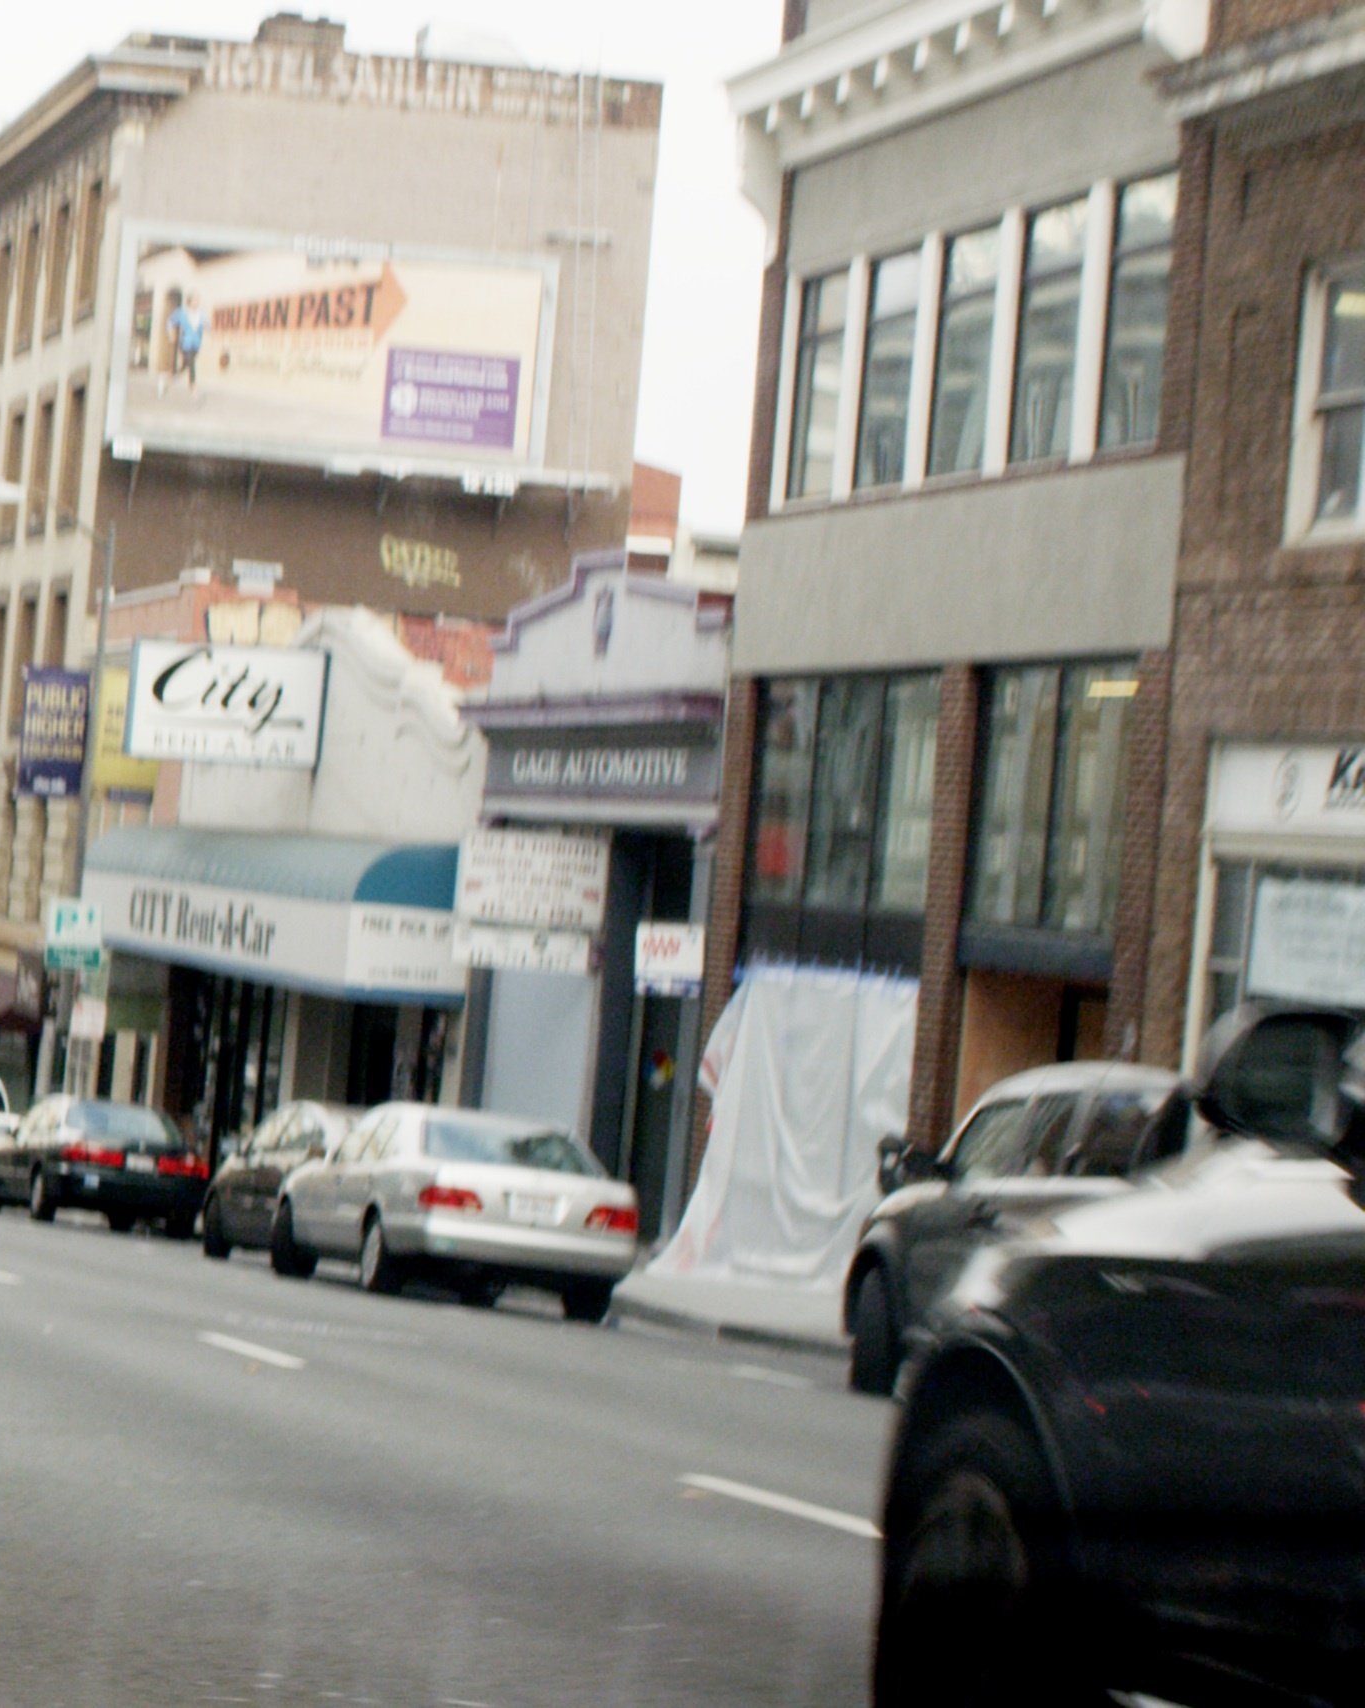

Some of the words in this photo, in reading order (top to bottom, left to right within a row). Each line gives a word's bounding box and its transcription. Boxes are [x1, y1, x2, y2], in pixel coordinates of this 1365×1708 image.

[212, 305, 242, 331] YOU
[246, 299, 290, 330] RAN
[297, 281, 382, 329] PAST
[26, 681, 87, 708] PUBLIC
[152, 646, 285, 736] City
[24, 712, 86, 738] HIGHER
[512, 750, 562, 784] GAGE
[562, 750, 689, 786] AUTOMOTIVE
[129, 887, 173, 937] CITY
